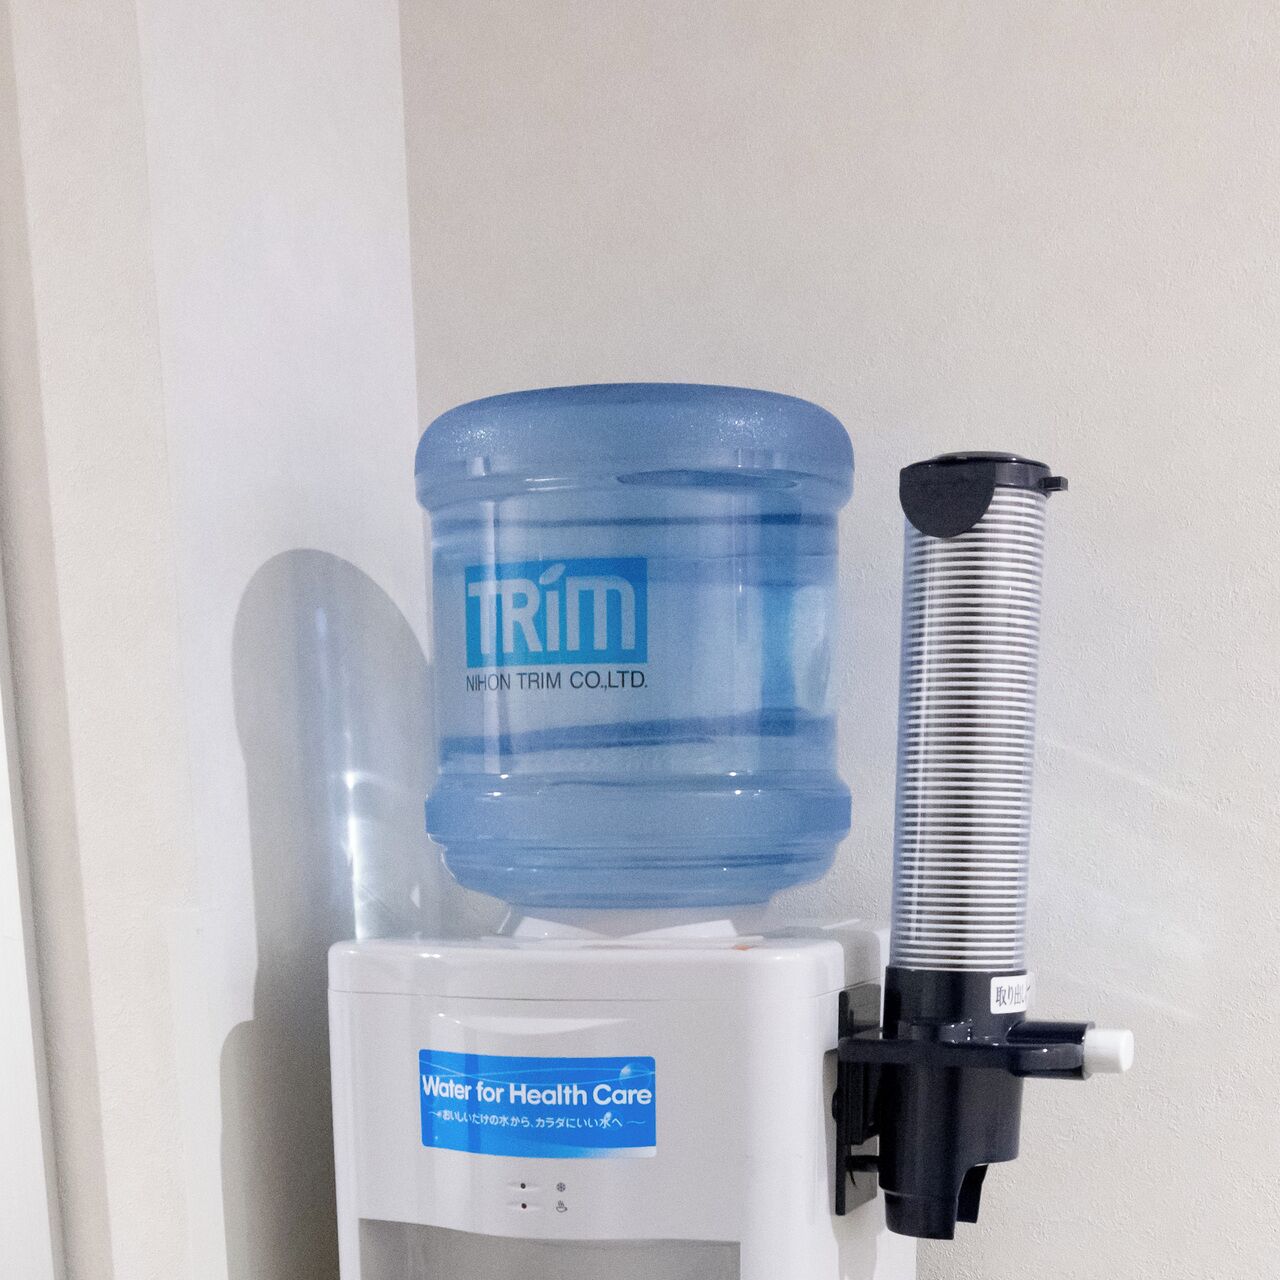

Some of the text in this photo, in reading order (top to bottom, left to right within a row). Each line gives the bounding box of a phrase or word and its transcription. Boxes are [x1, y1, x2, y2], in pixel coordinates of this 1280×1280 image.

[466, 673, 511, 691] NIHON
[516, 672, 561, 690] TRIM
[422, 1075, 652, 1106] Water for Health Care
